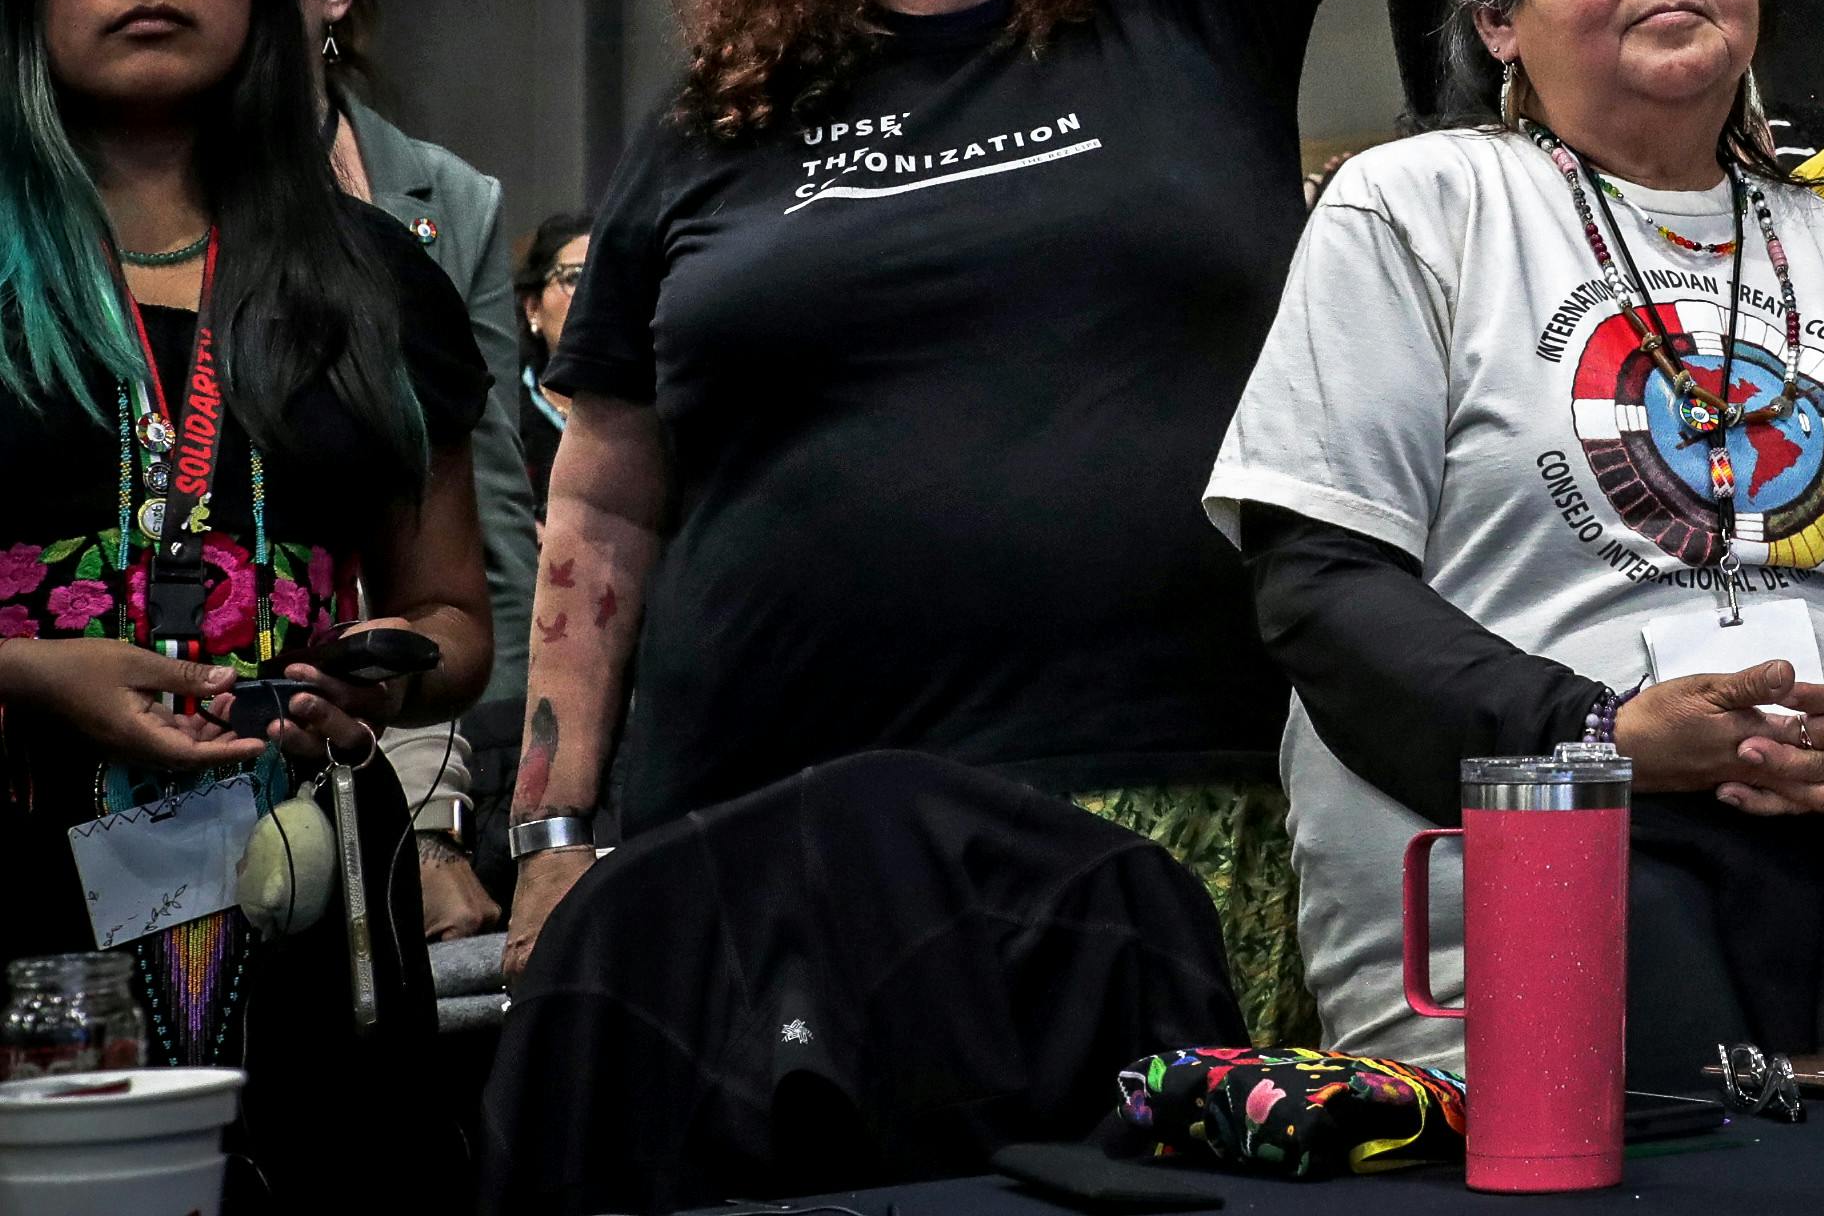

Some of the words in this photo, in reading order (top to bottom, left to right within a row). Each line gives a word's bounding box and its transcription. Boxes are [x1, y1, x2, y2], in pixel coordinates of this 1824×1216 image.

[1642, 269, 1719, 294] INDIAN
[1536, 450, 1604, 543] CONSEJO
[1758, 566, 1790, 592] DE
